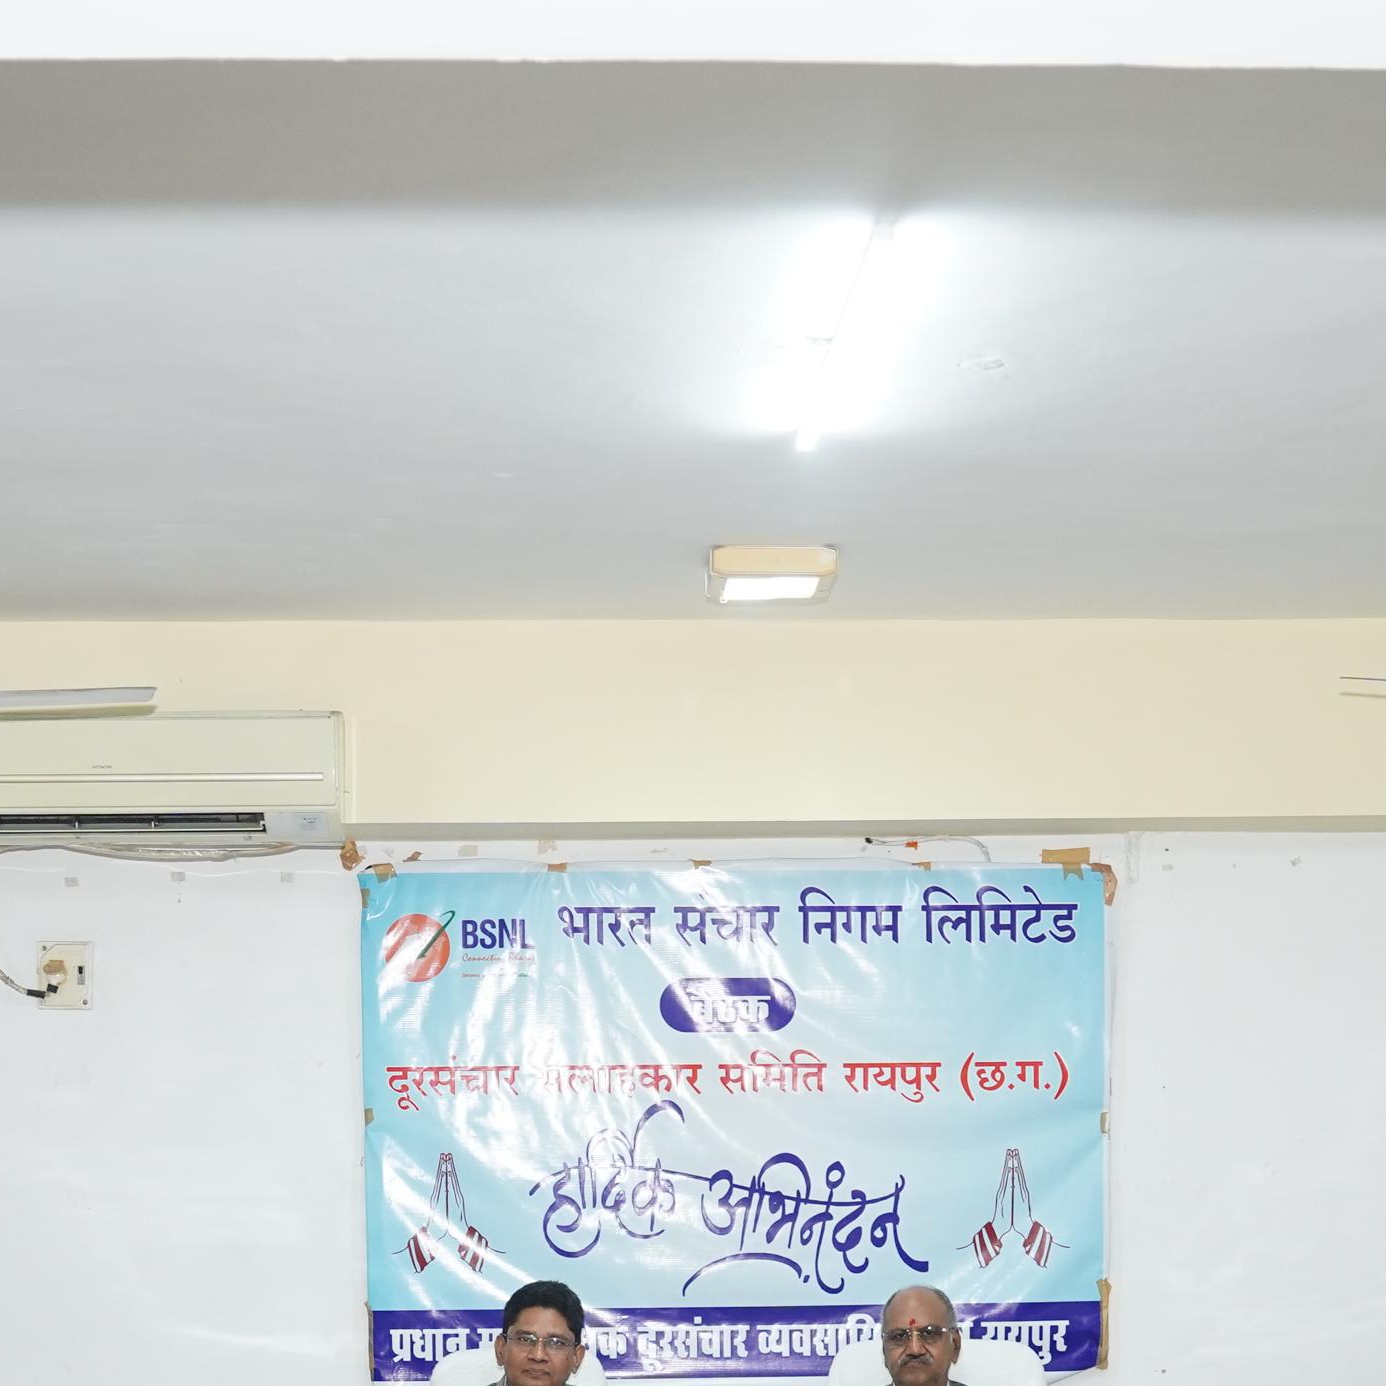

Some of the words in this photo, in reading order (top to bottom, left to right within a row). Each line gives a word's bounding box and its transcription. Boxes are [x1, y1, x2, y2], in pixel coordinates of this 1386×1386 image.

[461, 918, 535, 950] BSNL
[557, 905, 656, 947] भारत
[798, 886, 903, 945] निगम
[921, 885, 1079, 945] लिमिटेड
[386, 1055, 520, 1112] दूरसंचार
[718, 1049, 828, 1094] समिति
[842, 1061, 942, 1104] रायपुर
[959, 1051, 1070, 1101] (छ.ग.)
[530, 1100, 689, 1258] हार्दिक
[683, 1152, 929, 1297] अभिनंदन
[389, 1327, 470, 1363] प्रधान
[636, 1316, 751, 1372] दूरसंचार
